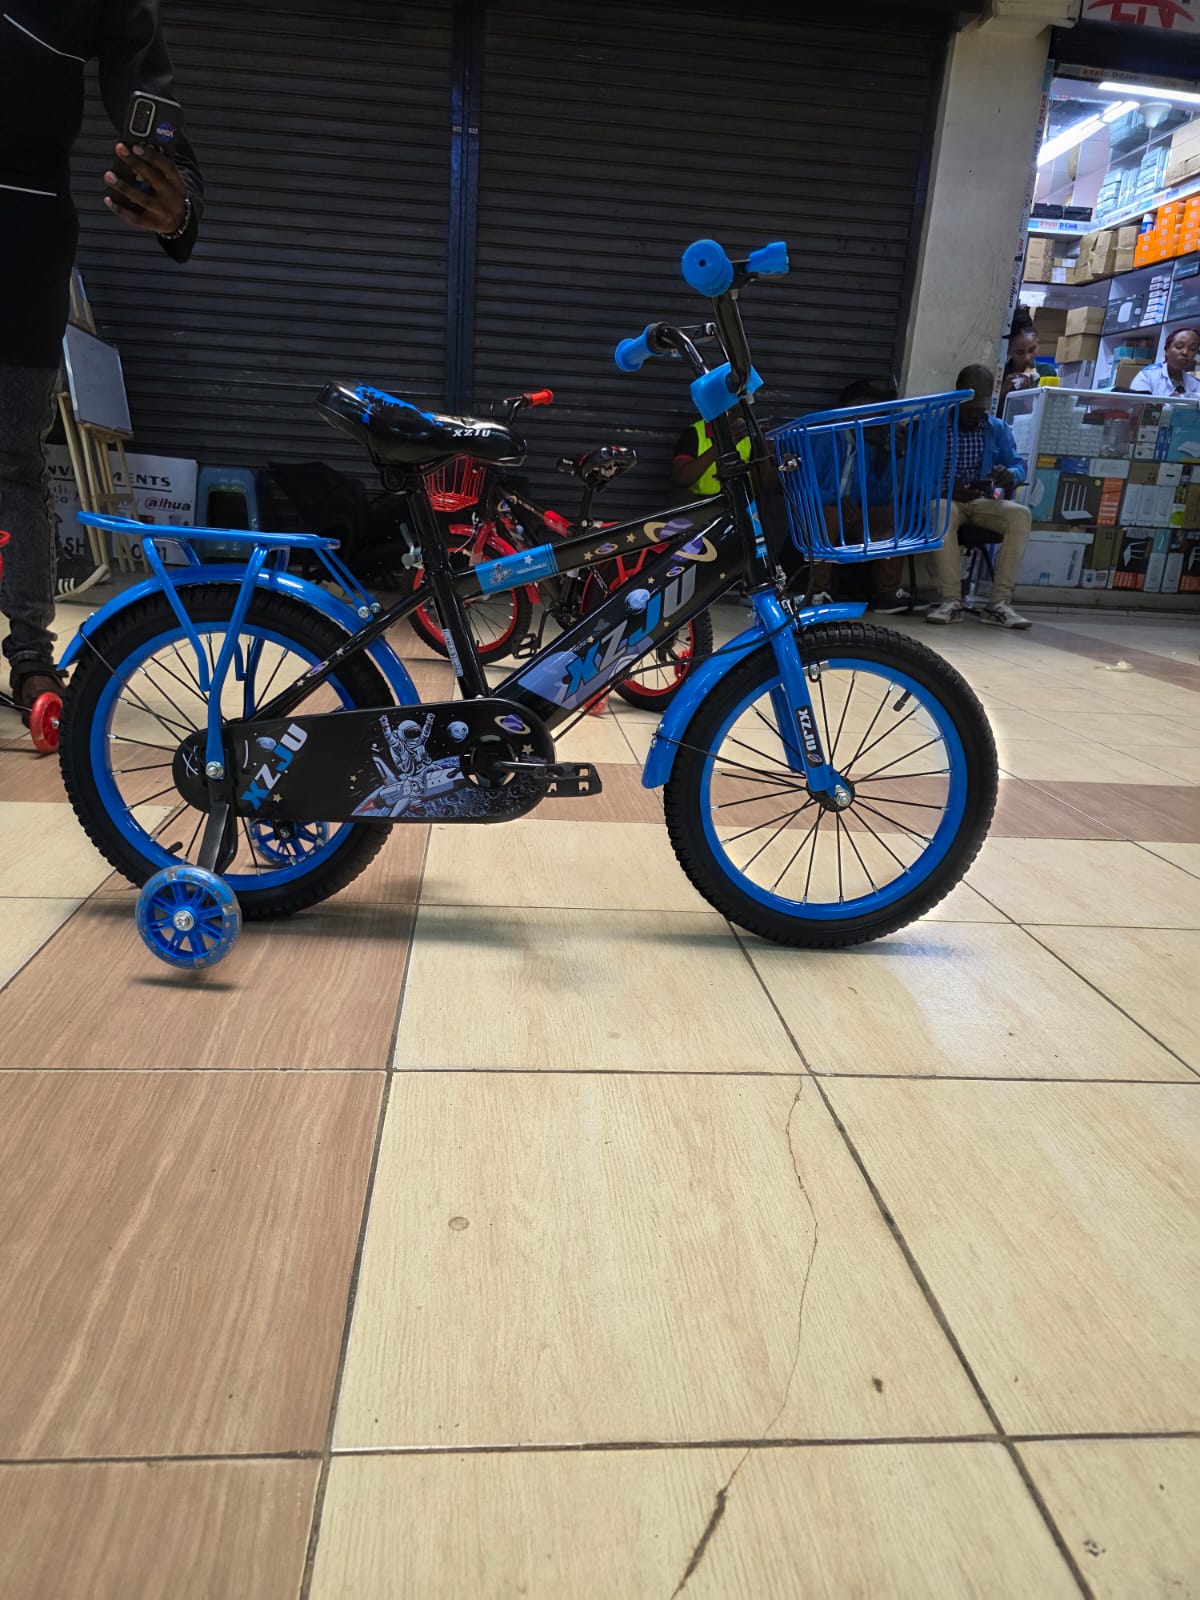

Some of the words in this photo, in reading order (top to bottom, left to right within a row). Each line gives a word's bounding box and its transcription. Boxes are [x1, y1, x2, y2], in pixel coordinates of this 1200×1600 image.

[564, 565, 696, 701] XZJU
[241, 722, 308, 811] XZJU
[797, 709, 816, 751] XZJU
